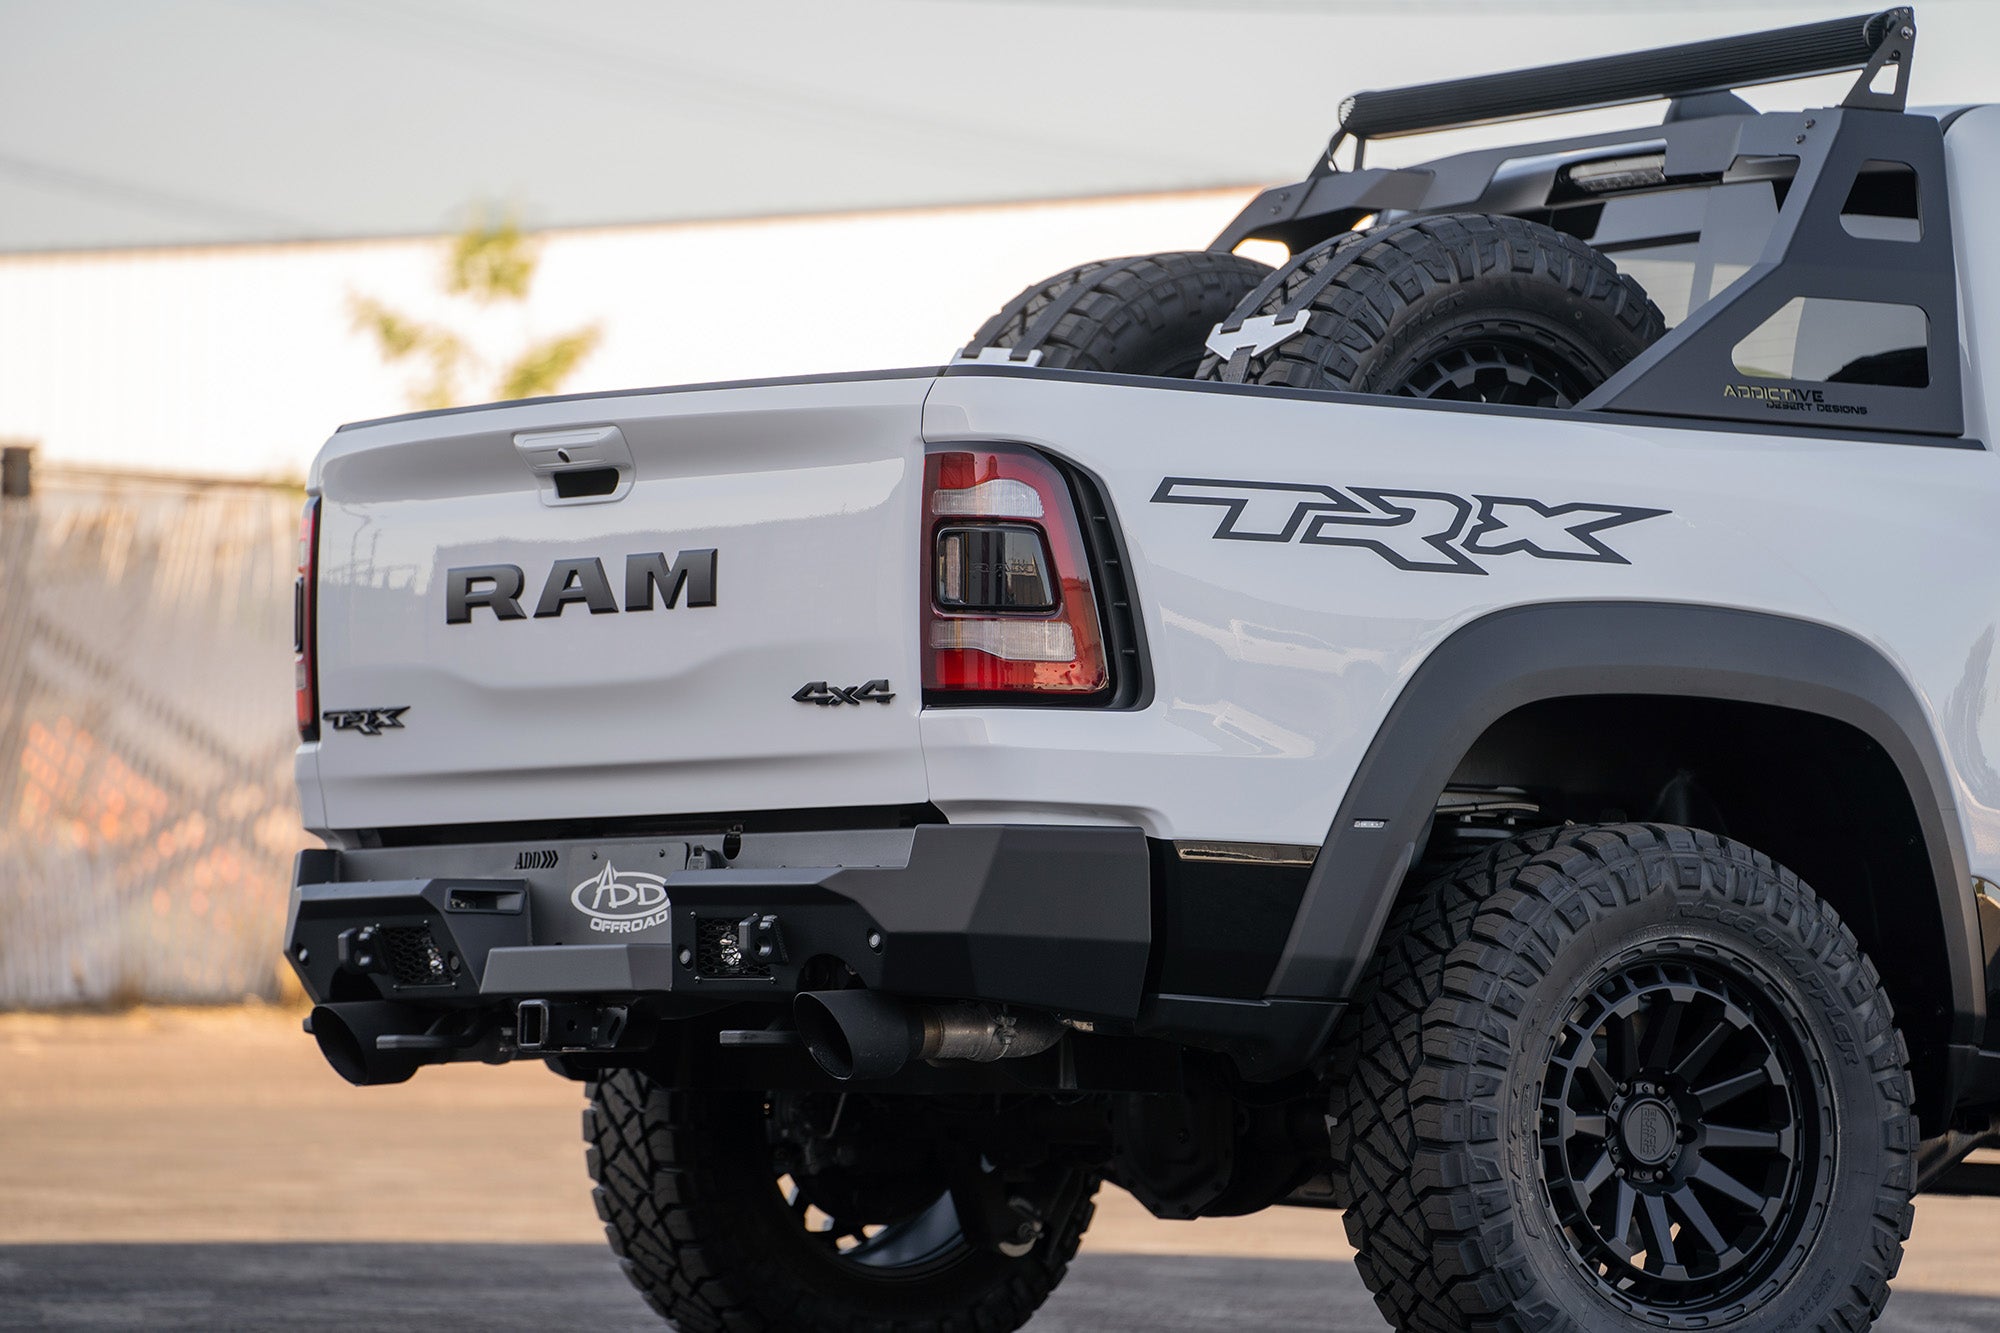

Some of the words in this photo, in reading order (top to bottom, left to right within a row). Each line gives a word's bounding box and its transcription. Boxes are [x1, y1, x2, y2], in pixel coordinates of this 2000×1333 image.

[1723, 384, 1825, 403] ADDICTIVE
[1766, 400, 1813, 412] DESERT
[1816, 403, 1868, 415] DESIGNS
[1149, 476, 1673, 576] TRX
[446, 548, 718, 625] RAM
[322, 706, 411, 735] TRX
[514, 851, 541, 870] ADD
[589, 910, 669, 934] OFFROAD
[1753, 926, 1860, 1067] GRAPPLER
